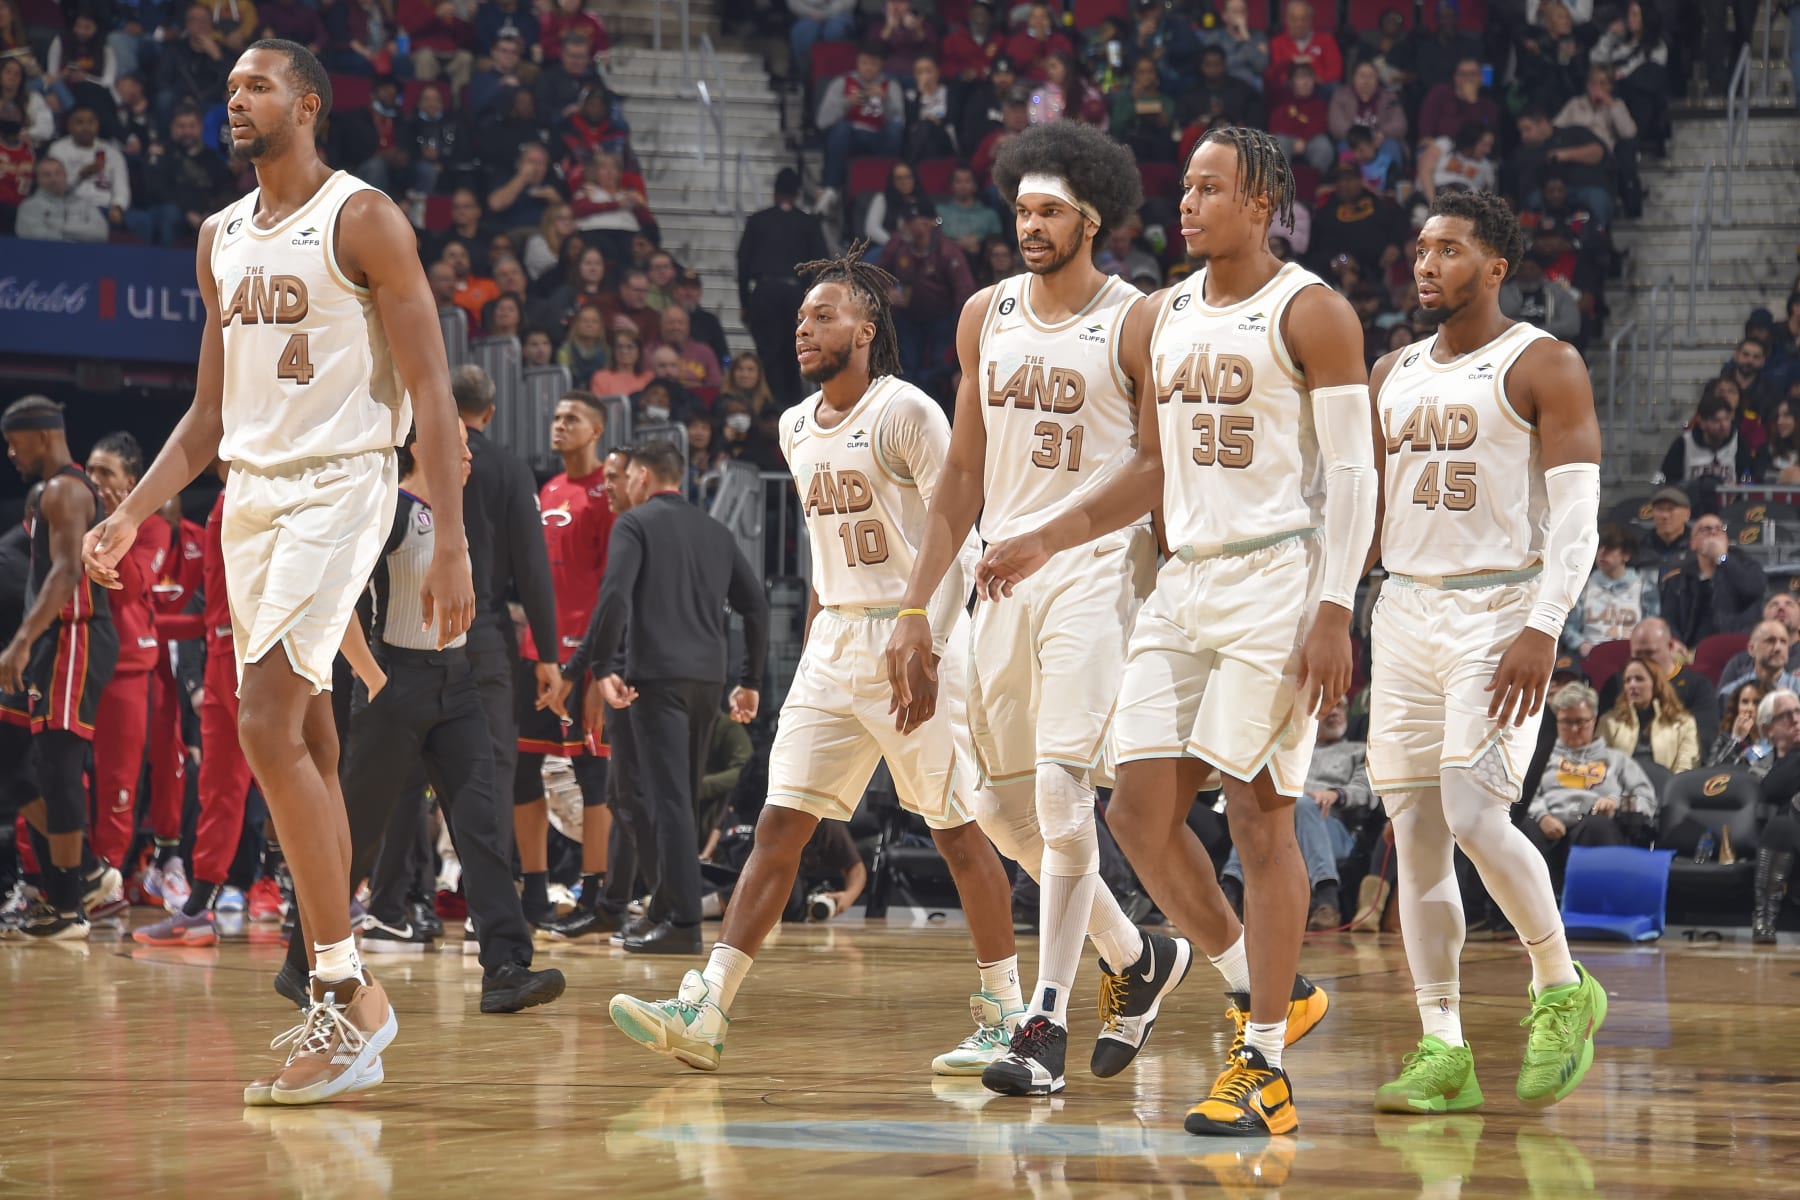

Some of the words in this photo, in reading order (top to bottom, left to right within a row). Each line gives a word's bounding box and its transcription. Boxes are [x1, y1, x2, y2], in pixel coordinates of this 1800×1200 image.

[245, 266, 265, 275] THE
[1001, 299, 1015, 315] 6
[1175, 294, 1191, 310] 6
[1079, 333, 1106, 344] CLIFFS
[1238, 324, 1266, 332] CLIFFS
[277, 333, 314, 385] 4
[1024, 355, 1045, 365] THE
[1192, 343, 1211, 353] THE
[987, 361, 1086, 414] LAND
[1156, 353, 1253, 405] LAND
[1420, 396, 1440, 405] THE
[1192, 413, 1254, 469] 35
[1384, 404, 1478, 455] LAND
[1032, 420, 1084, 472] 31
[814, 462, 831, 471] THE
[797, 469, 873, 517] AND
[1412, 461, 1476, 511] 45
[838, 519, 889, 567] 10
